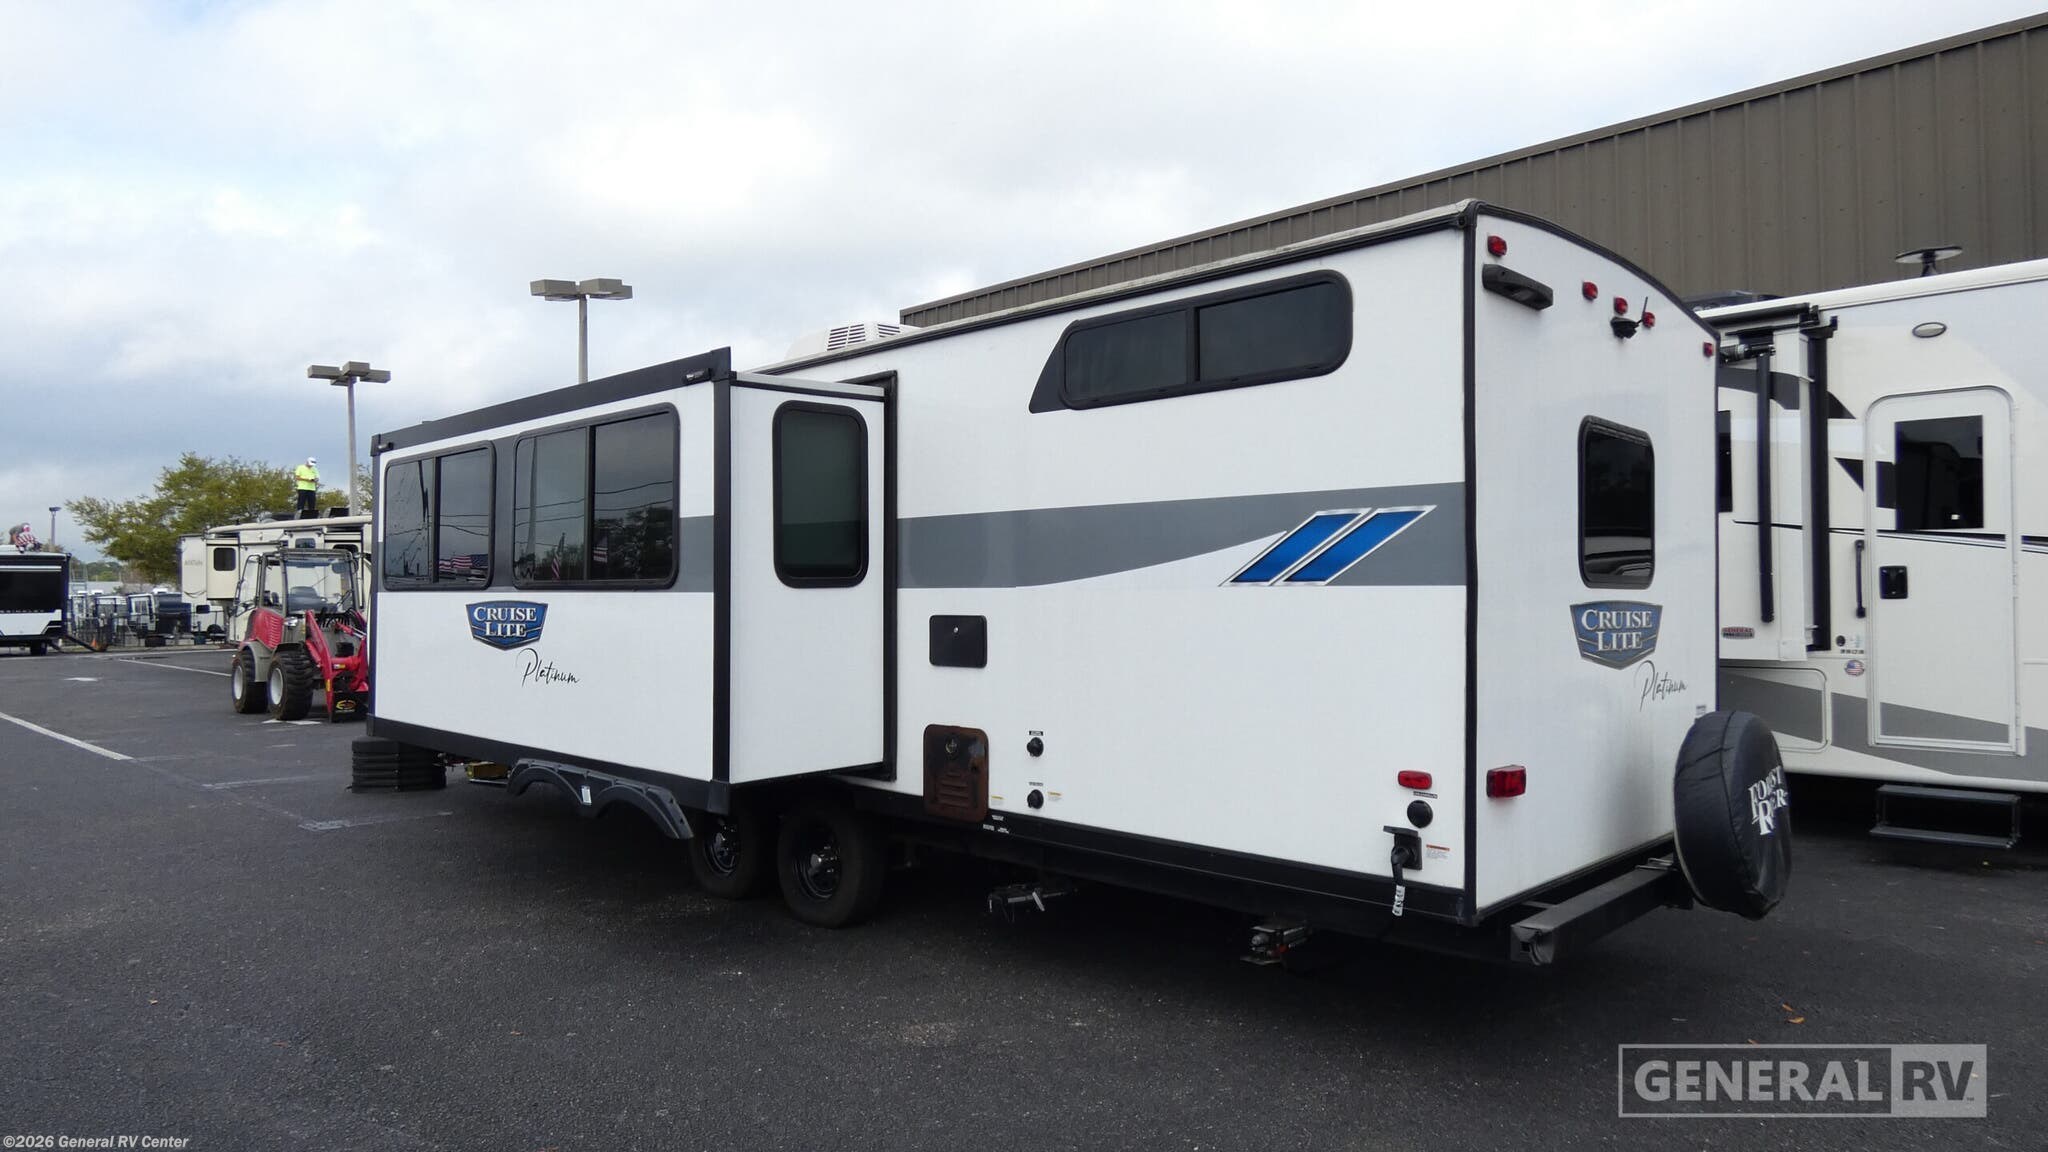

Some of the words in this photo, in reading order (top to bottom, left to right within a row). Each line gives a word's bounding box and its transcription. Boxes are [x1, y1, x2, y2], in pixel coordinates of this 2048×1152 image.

[474, 606, 537, 622] CRUISE
[1581, 609, 1653, 630] CRUISE
[485, 622, 527, 638] LITE
[1596, 631, 1643, 652] LITE
[516, 648, 580, 687] Platinum
[1634, 660, 1688, 712] Platinum
